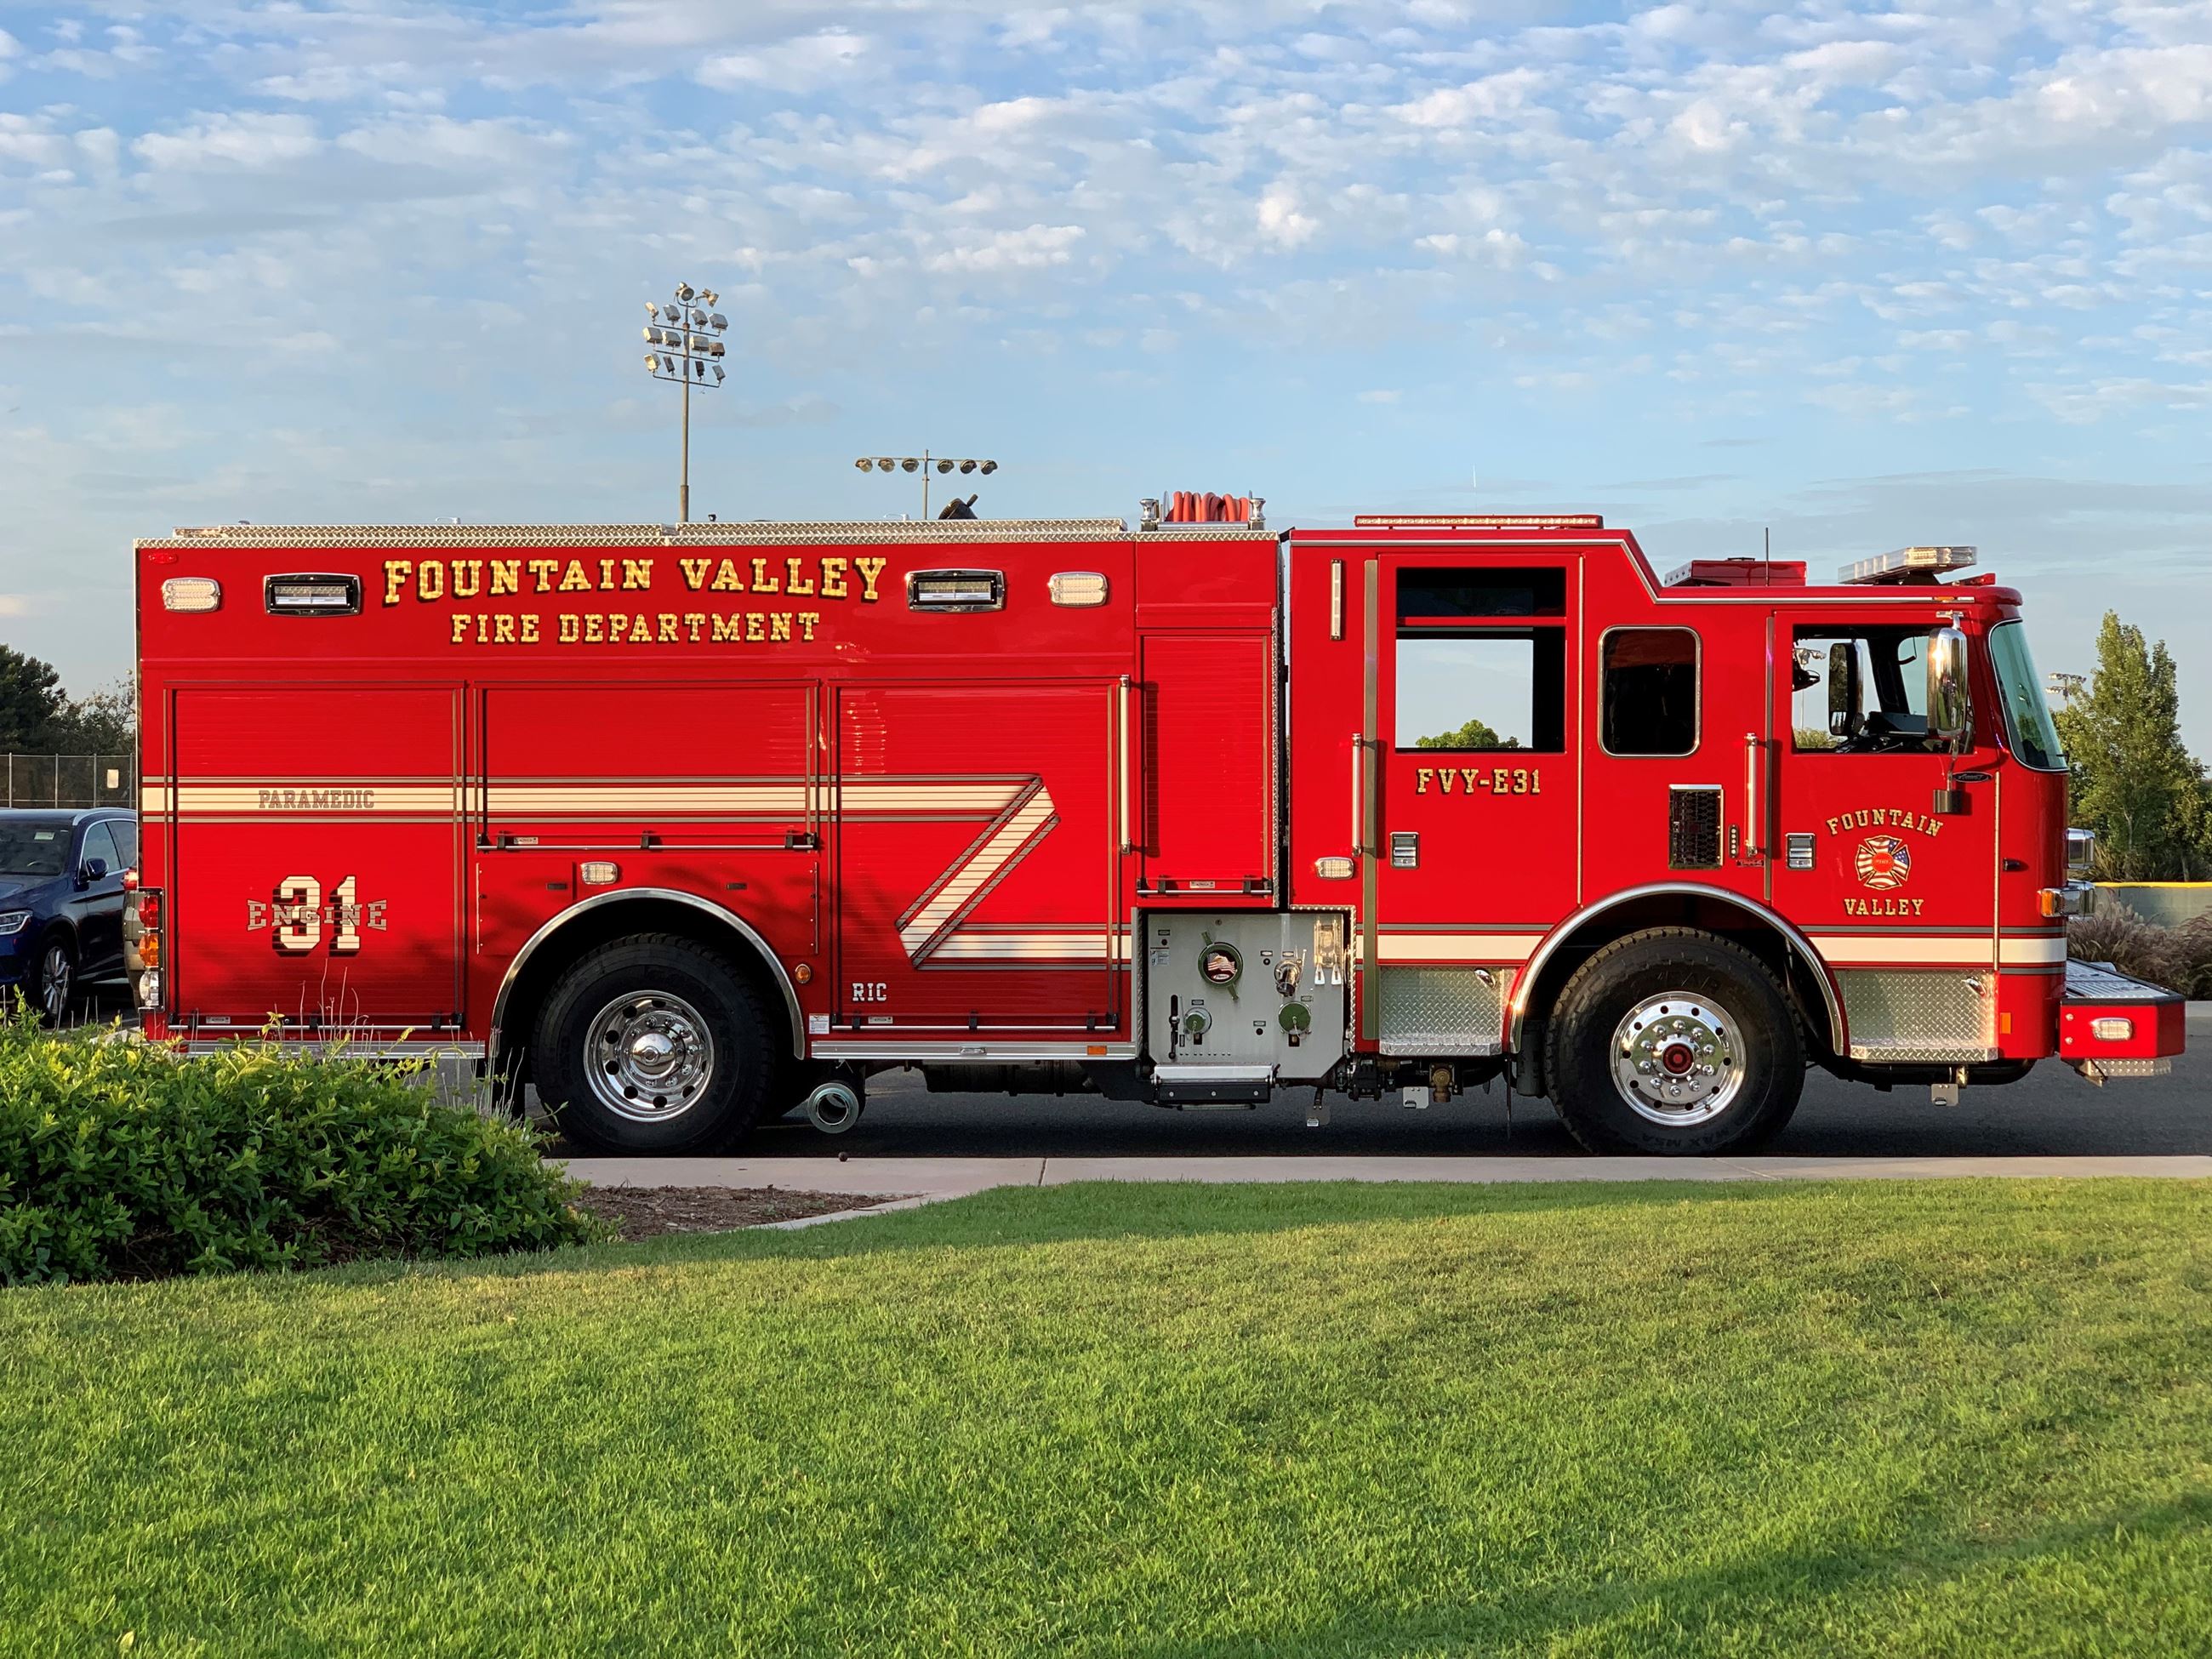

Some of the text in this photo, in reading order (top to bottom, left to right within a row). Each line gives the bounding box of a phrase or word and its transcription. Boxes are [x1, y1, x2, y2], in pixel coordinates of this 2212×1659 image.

[384, 557, 887, 605] FOUNTAIN VALLEY
[451, 612, 820, 644] FIRE DEPARTMENT
[1417, 768, 1542, 795] FVY-E31
[259, 790, 375, 809] PARAMEDIC
[1827, 808, 1943, 838] FOUNTAIN
[247, 899, 387, 932] ENGINE
[273, 875, 361, 953] 31
[1844, 898, 1924, 915] VALLEY
[852, 983, 887, 1002] RIC
